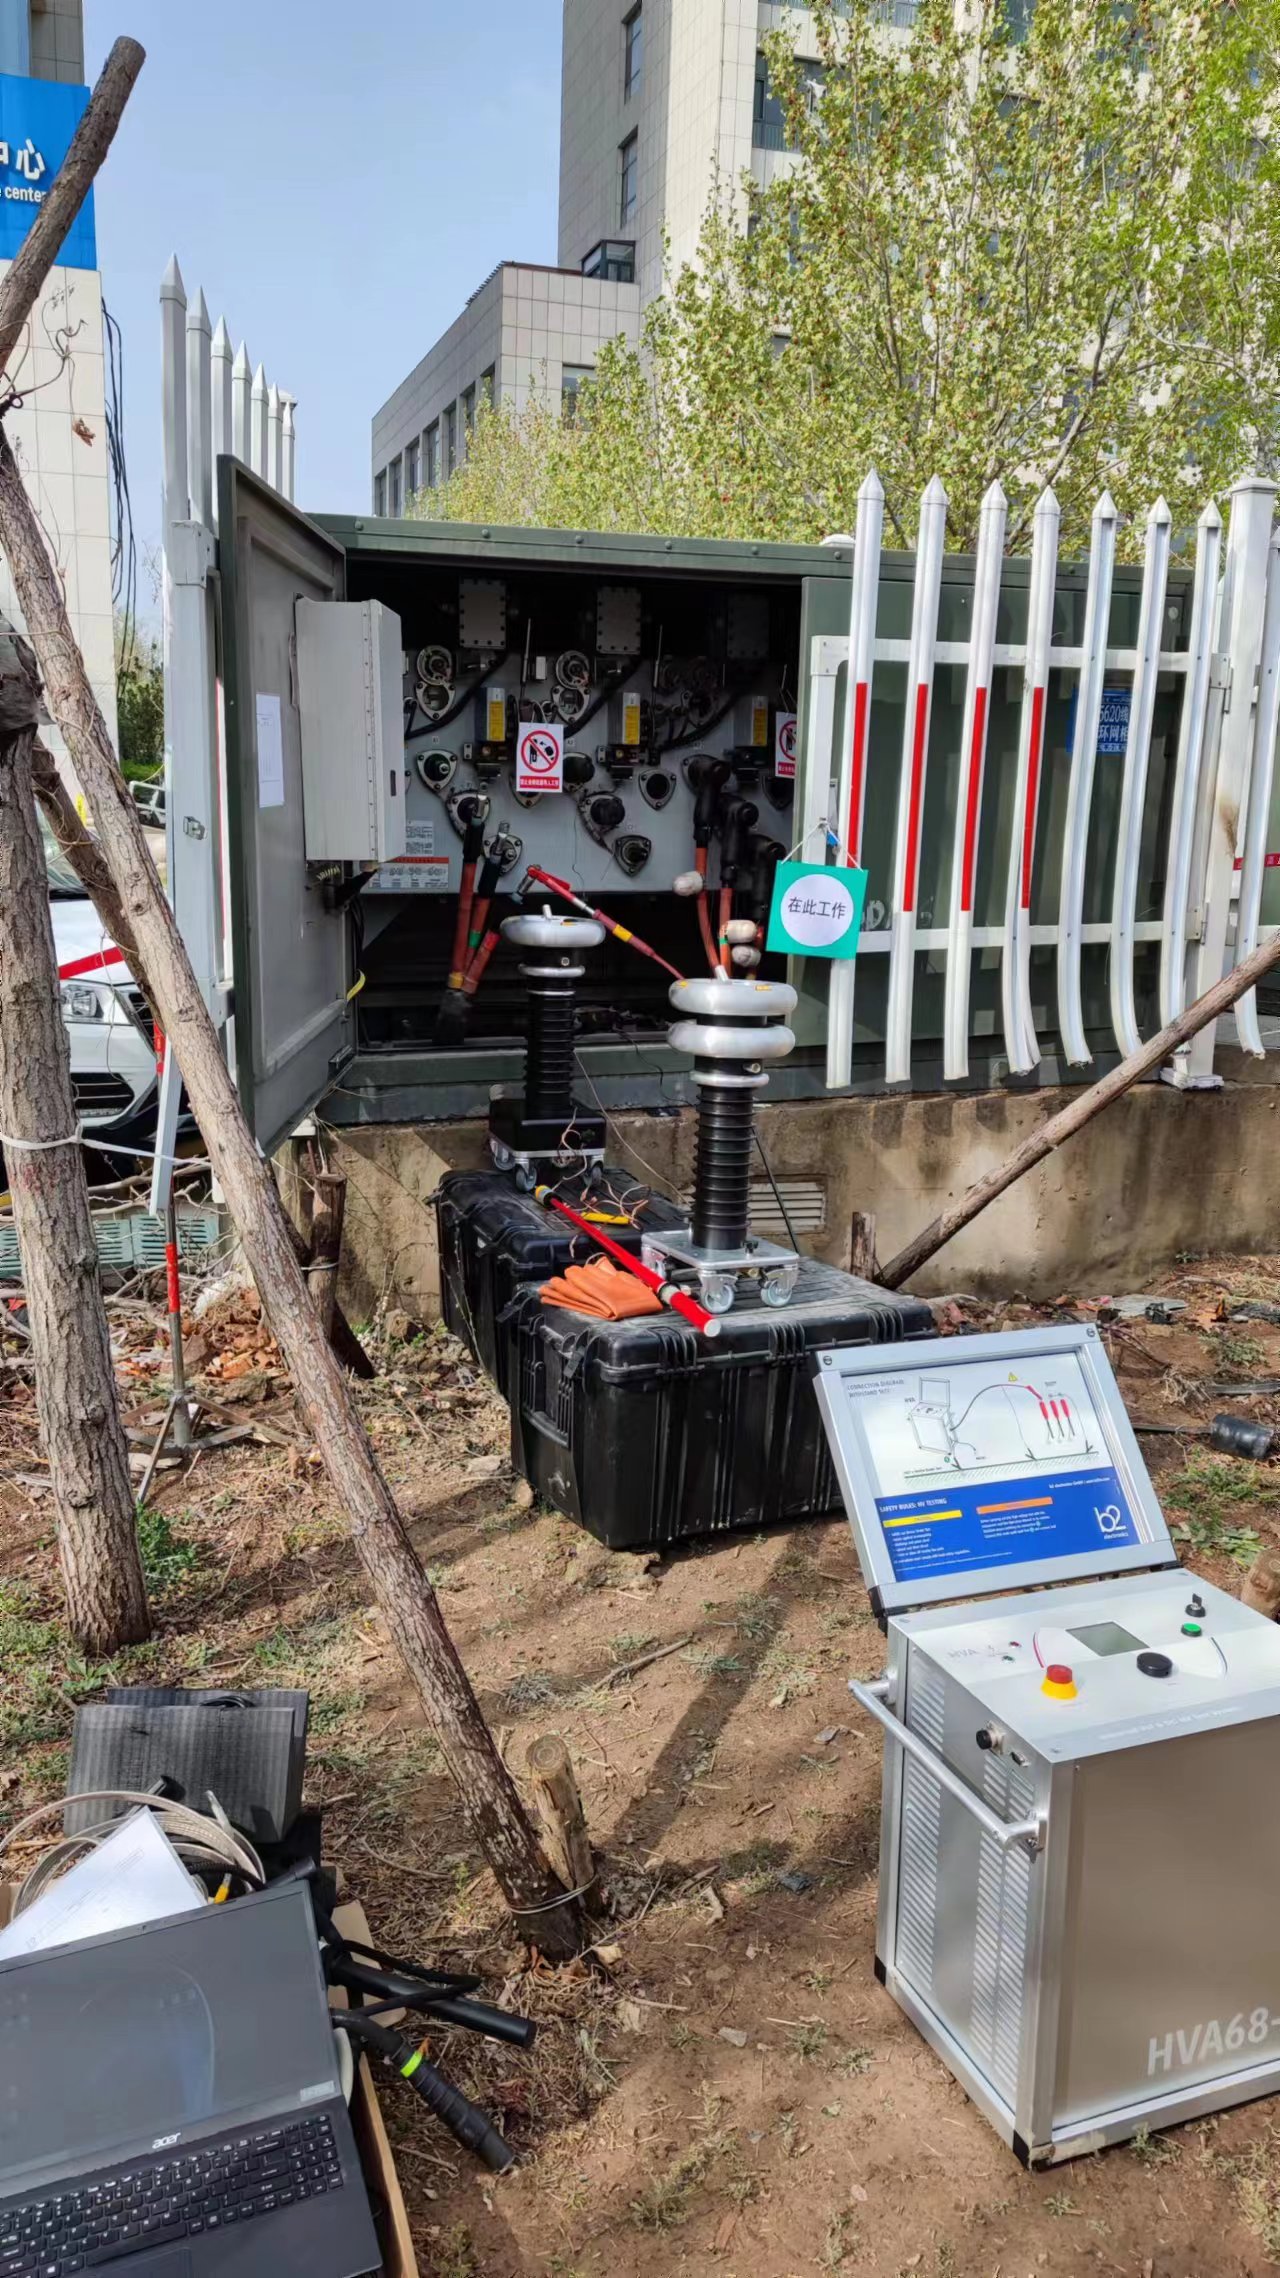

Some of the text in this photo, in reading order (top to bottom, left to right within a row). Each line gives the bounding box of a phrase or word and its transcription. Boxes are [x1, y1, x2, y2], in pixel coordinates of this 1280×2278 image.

[788, 896, 846, 920] 在此工作
[880, 1504, 898, 1513] SAFETY
[926, 1498, 947, 1506] TESTING
[152, 2132, 182, 2149] acer
